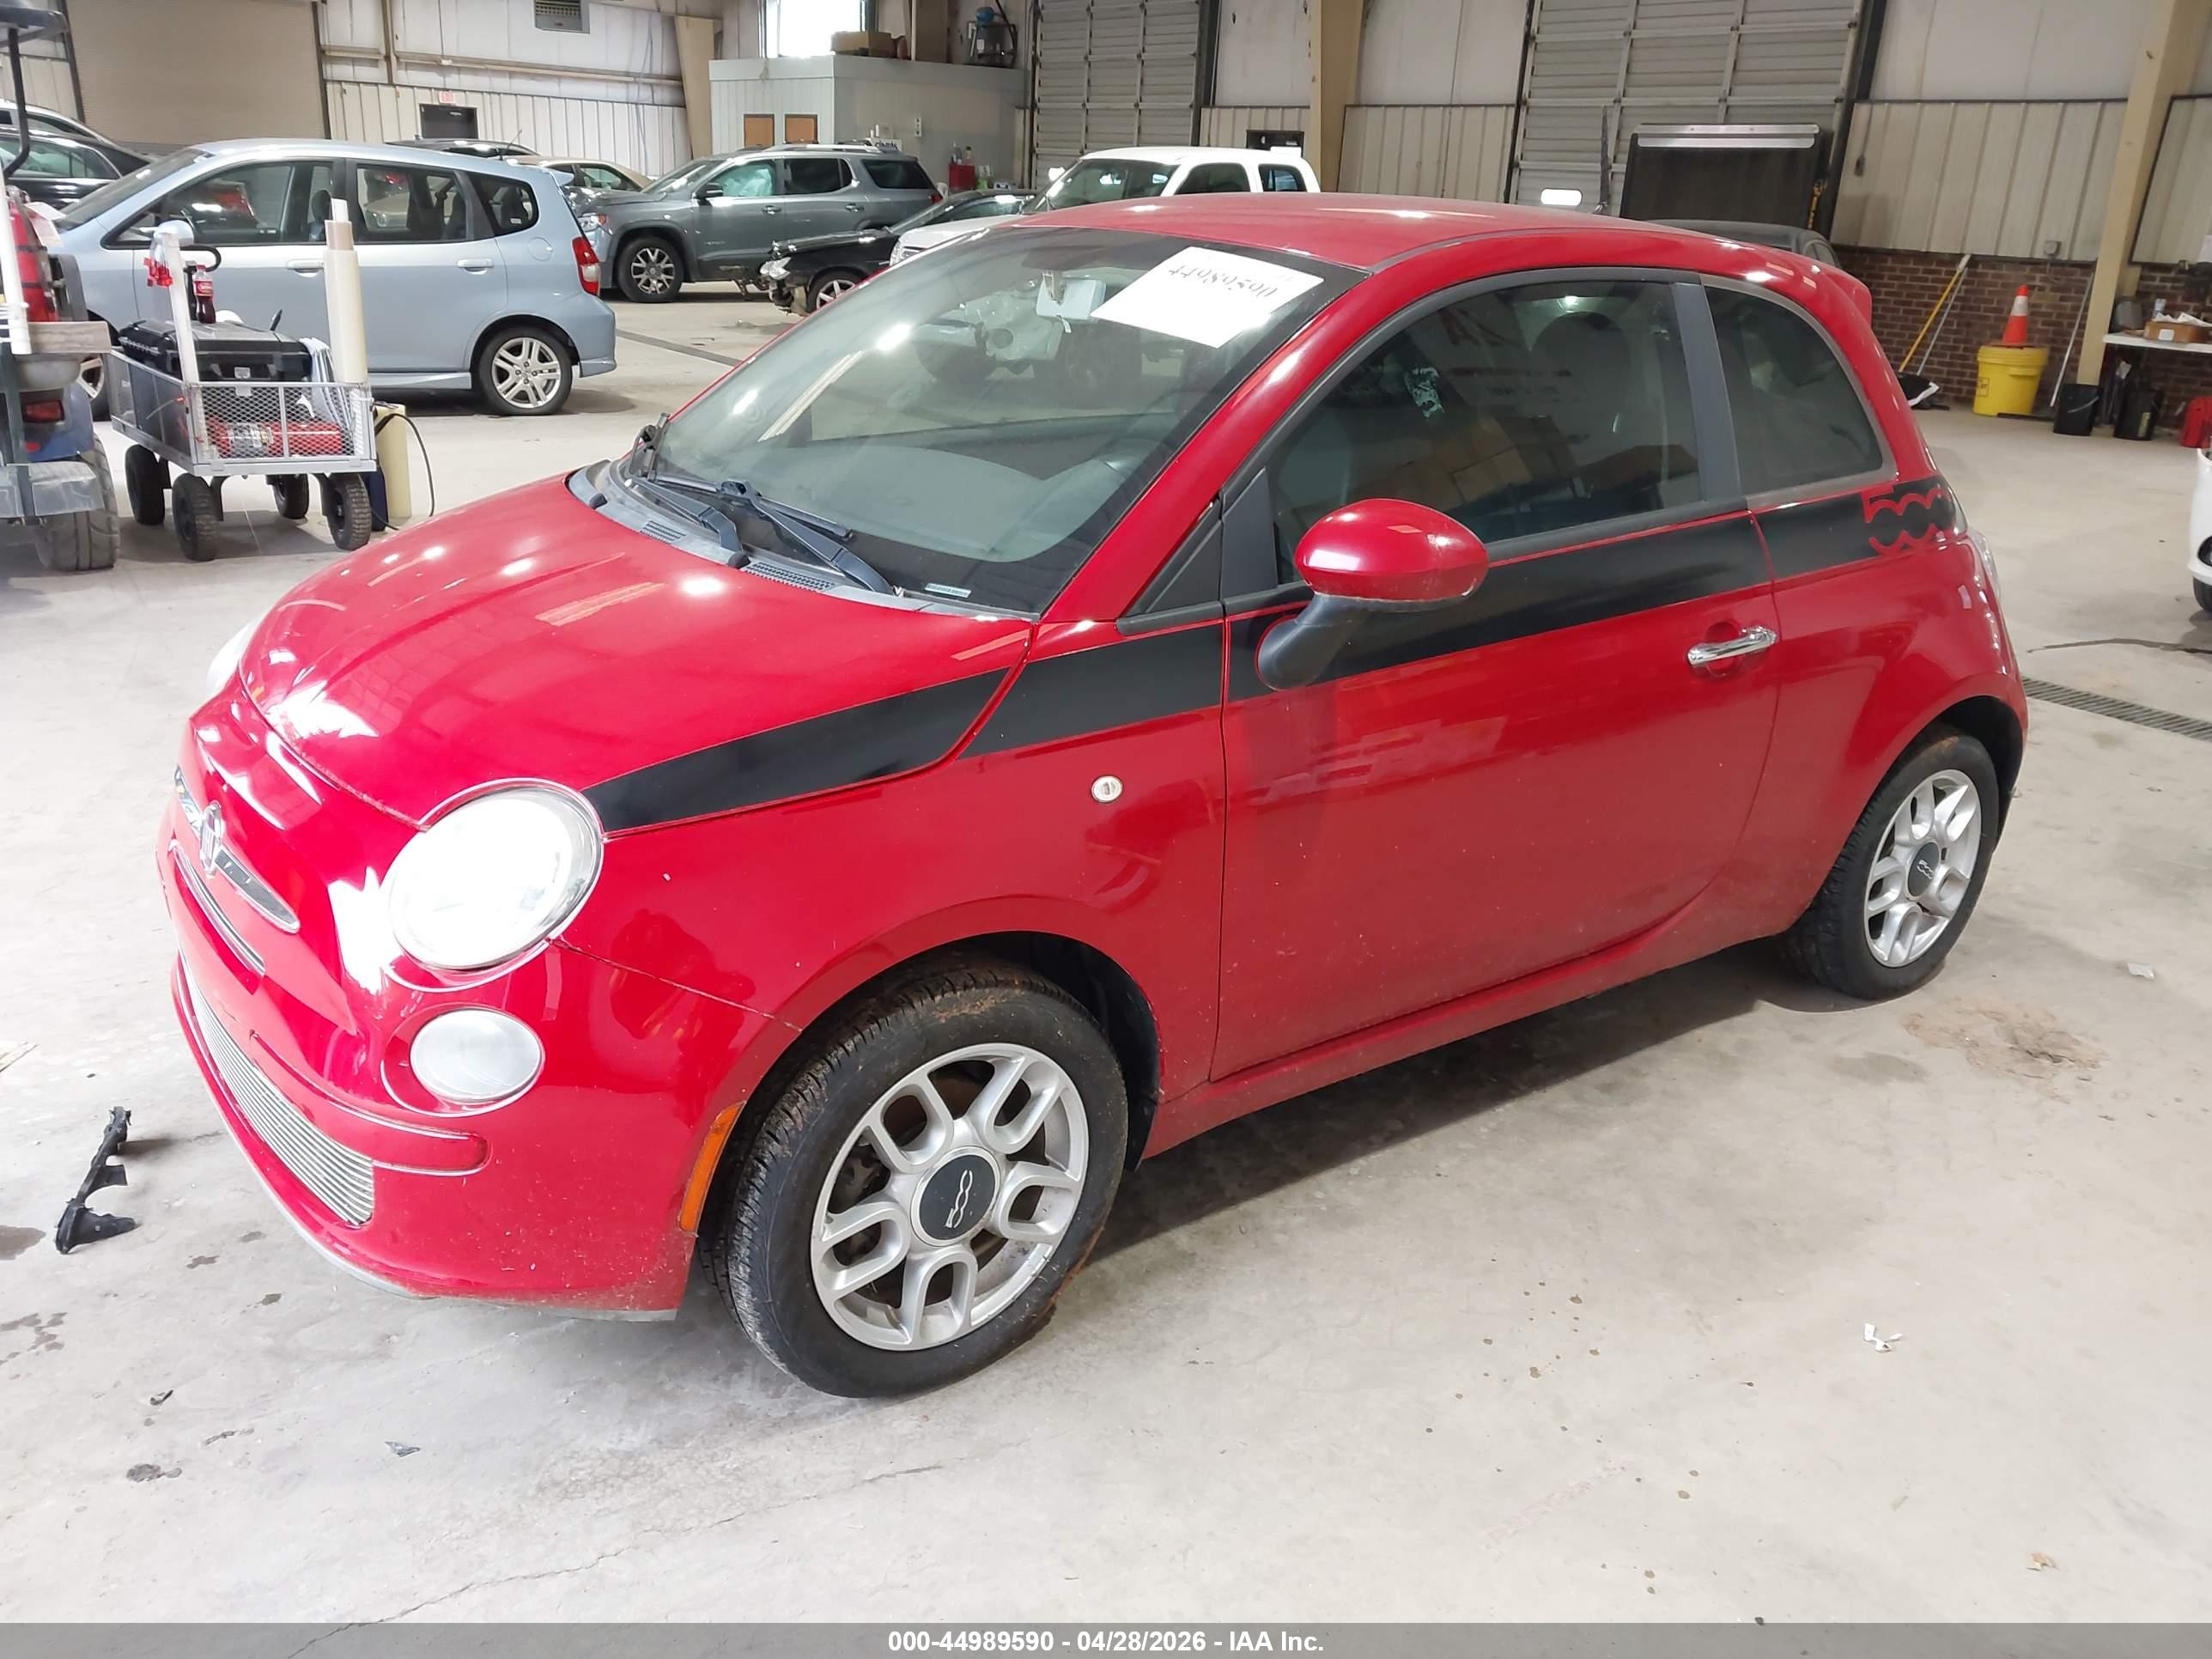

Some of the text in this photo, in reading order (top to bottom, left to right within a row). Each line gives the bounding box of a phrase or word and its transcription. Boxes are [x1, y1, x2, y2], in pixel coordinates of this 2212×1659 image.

[1168, 264, 1279, 299] 44989590
[1861, 484, 1954, 555] 500
[945, 1169, 974, 1229] 500
